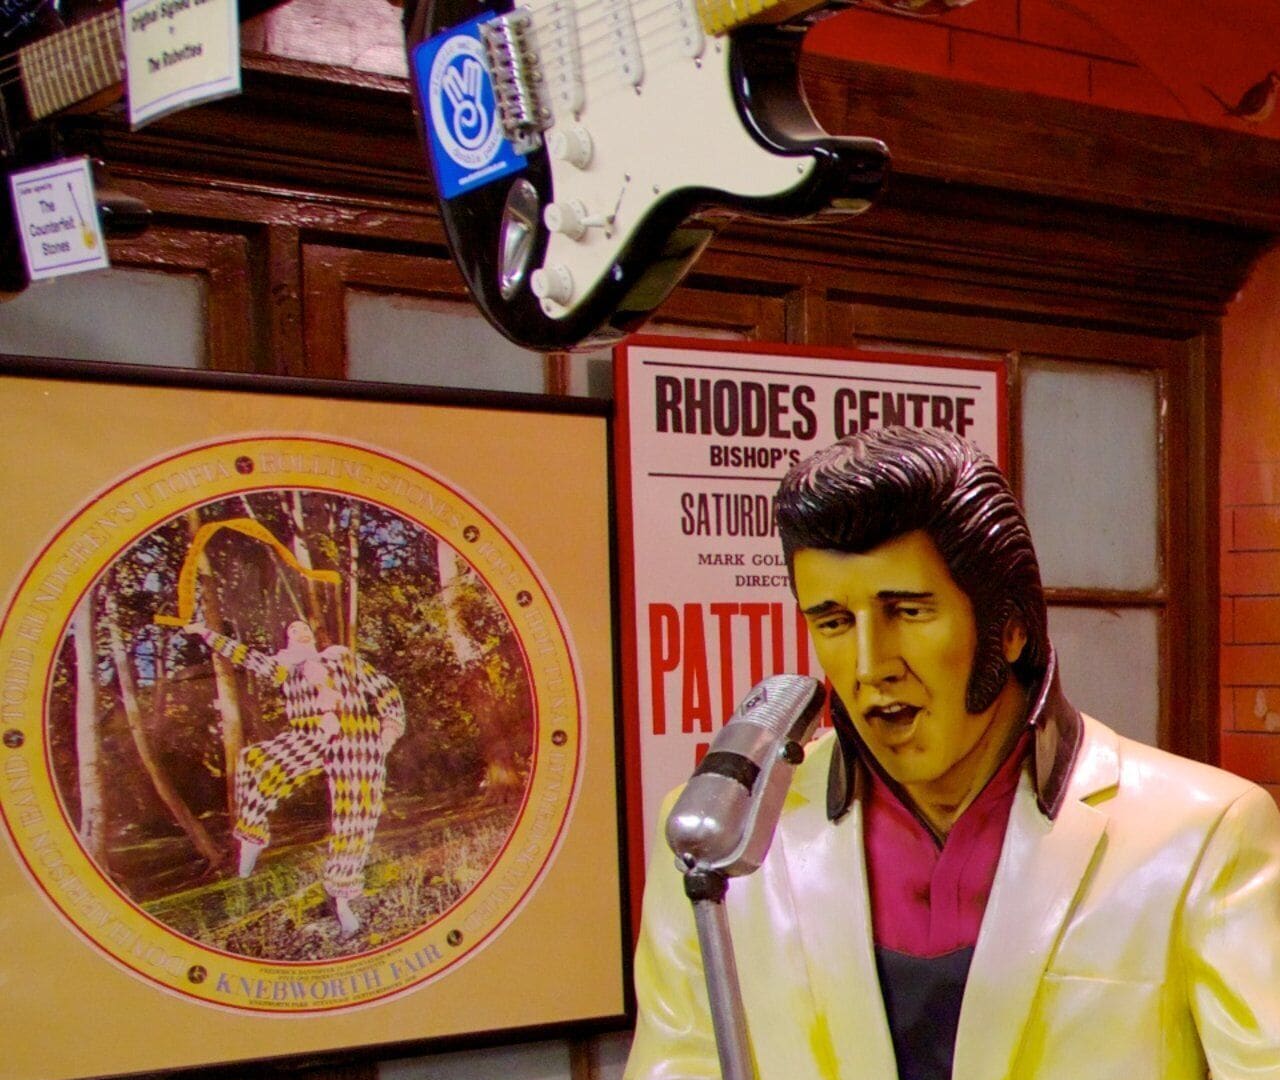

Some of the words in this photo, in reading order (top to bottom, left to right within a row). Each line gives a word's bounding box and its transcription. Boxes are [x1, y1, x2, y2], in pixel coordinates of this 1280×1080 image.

[39, 200, 56, 213] The
[41, 241, 72, 256] Stones
[655, 375, 818, 440] RHODES
[834, 386, 976, 440] CENTRE
[710, 445, 800, 468] BISHOP'S
[259, 453, 374, 487] ROLLING
[377, 469, 461, 530] STONES
[698, 554, 745, 566] MARK
[752, 554, 786, 566] GOL
[216, 967, 384, 1001] KNEBWORTH
[390, 942, 443, 981] FAIR
